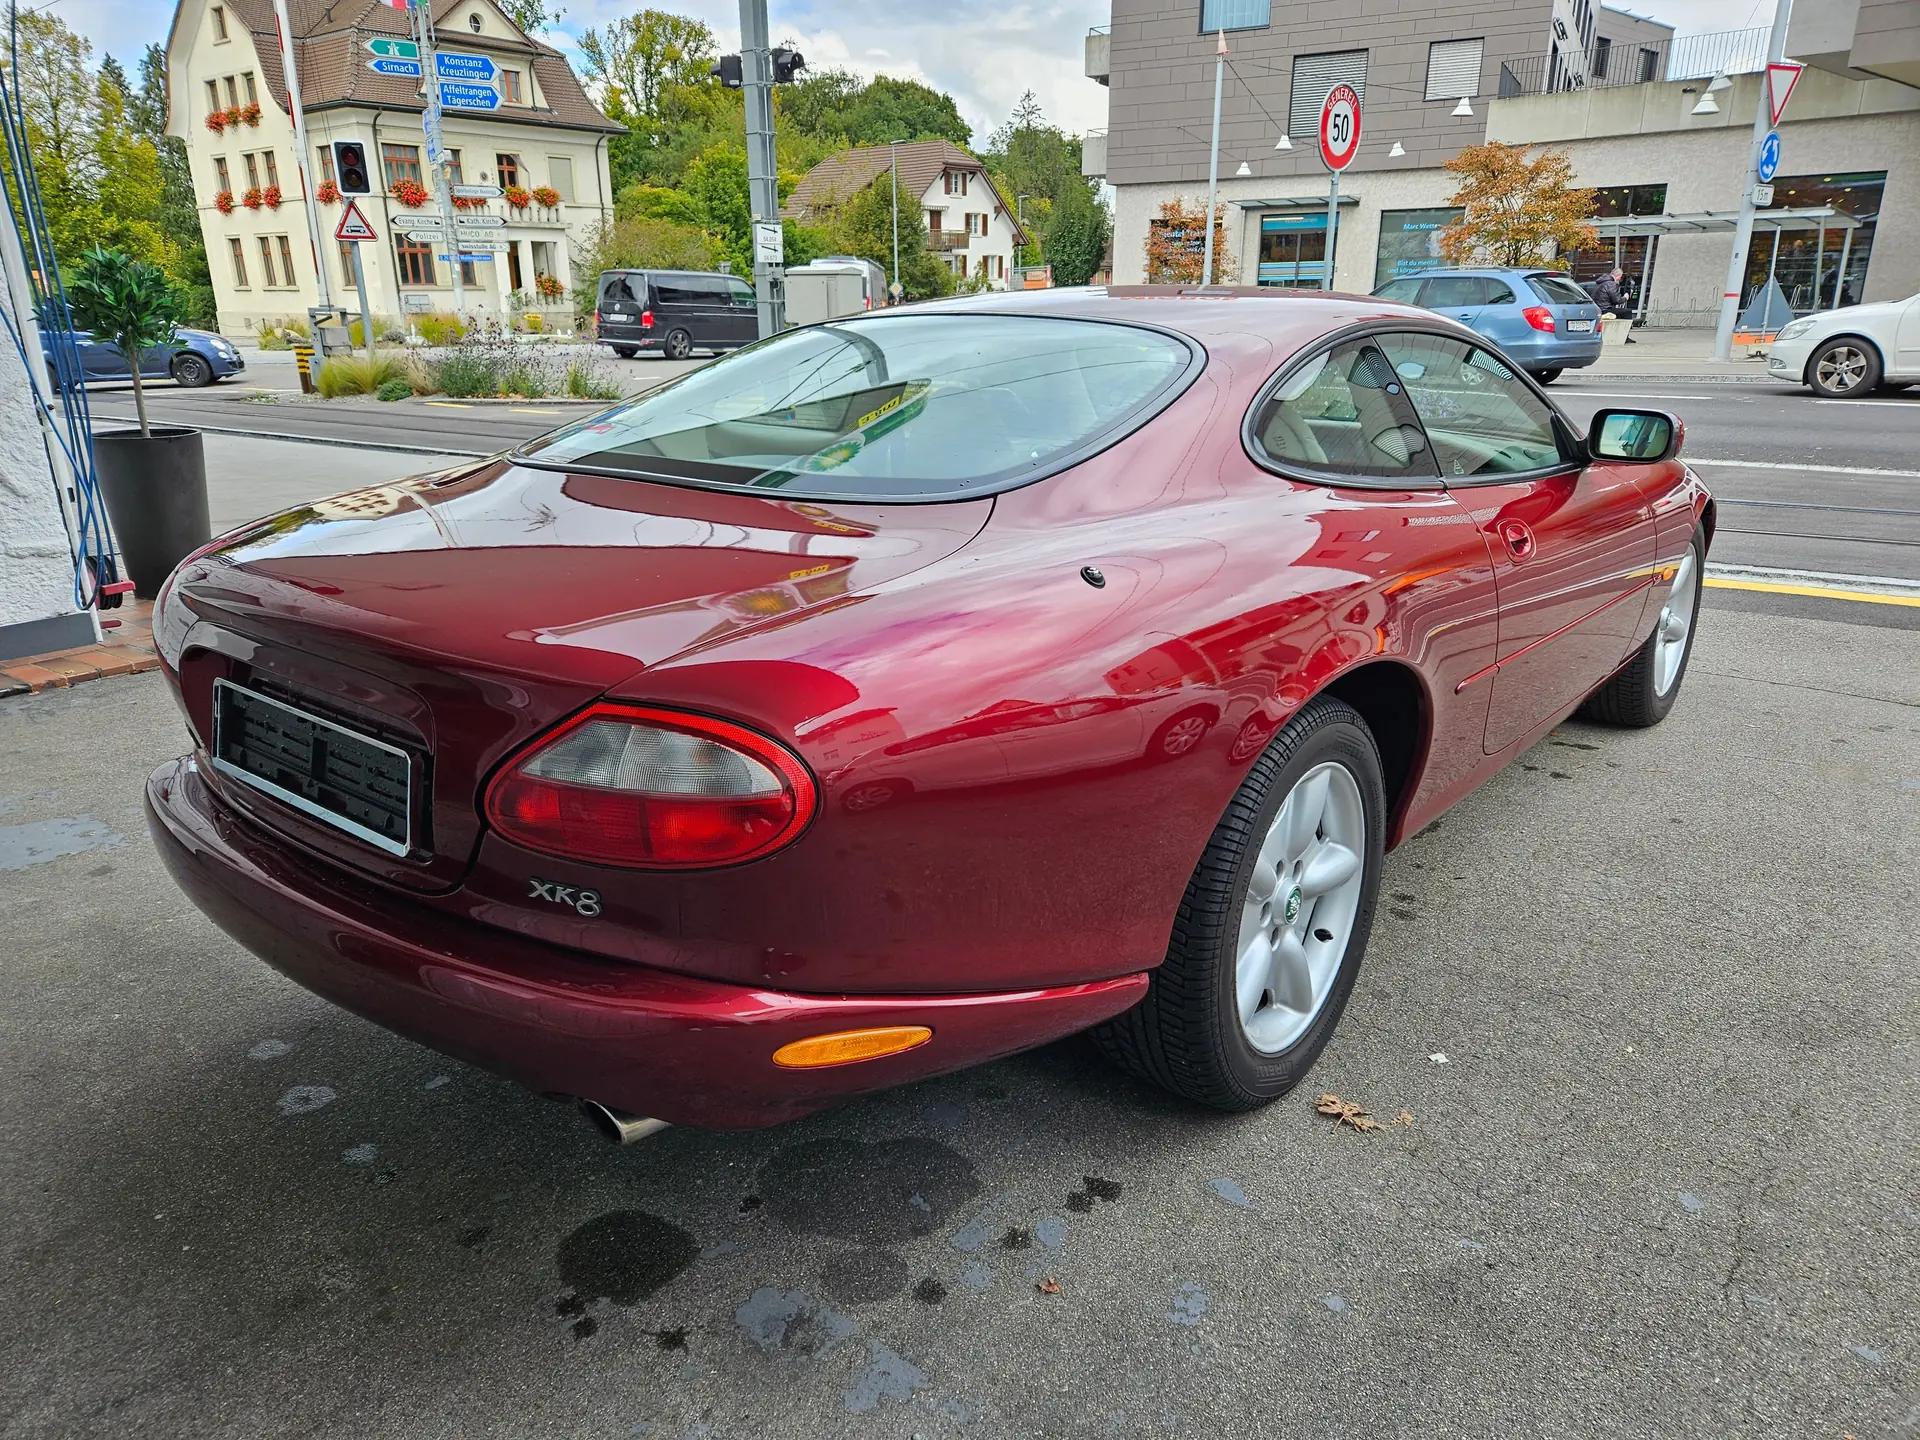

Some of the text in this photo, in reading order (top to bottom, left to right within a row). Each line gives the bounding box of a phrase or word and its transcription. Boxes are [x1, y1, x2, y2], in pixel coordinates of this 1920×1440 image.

[382, 61, 415, 73] Sirnach
[444, 56, 482, 68] Konstanz
[440, 66, 490, 79] Kreuzlingen
[443, 85, 493, 97] Affeltrangen
[446, 95, 491, 107] Tägerschen
[1327, 87, 1358, 112] GENERELL
[1332, 113, 1349, 143] 50
[398, 217, 415, 227] Evang.
[466, 215, 499, 225] Kath. Kirche
[415, 232, 439, 240] Polizei
[528, 879, 601, 918] XK8
